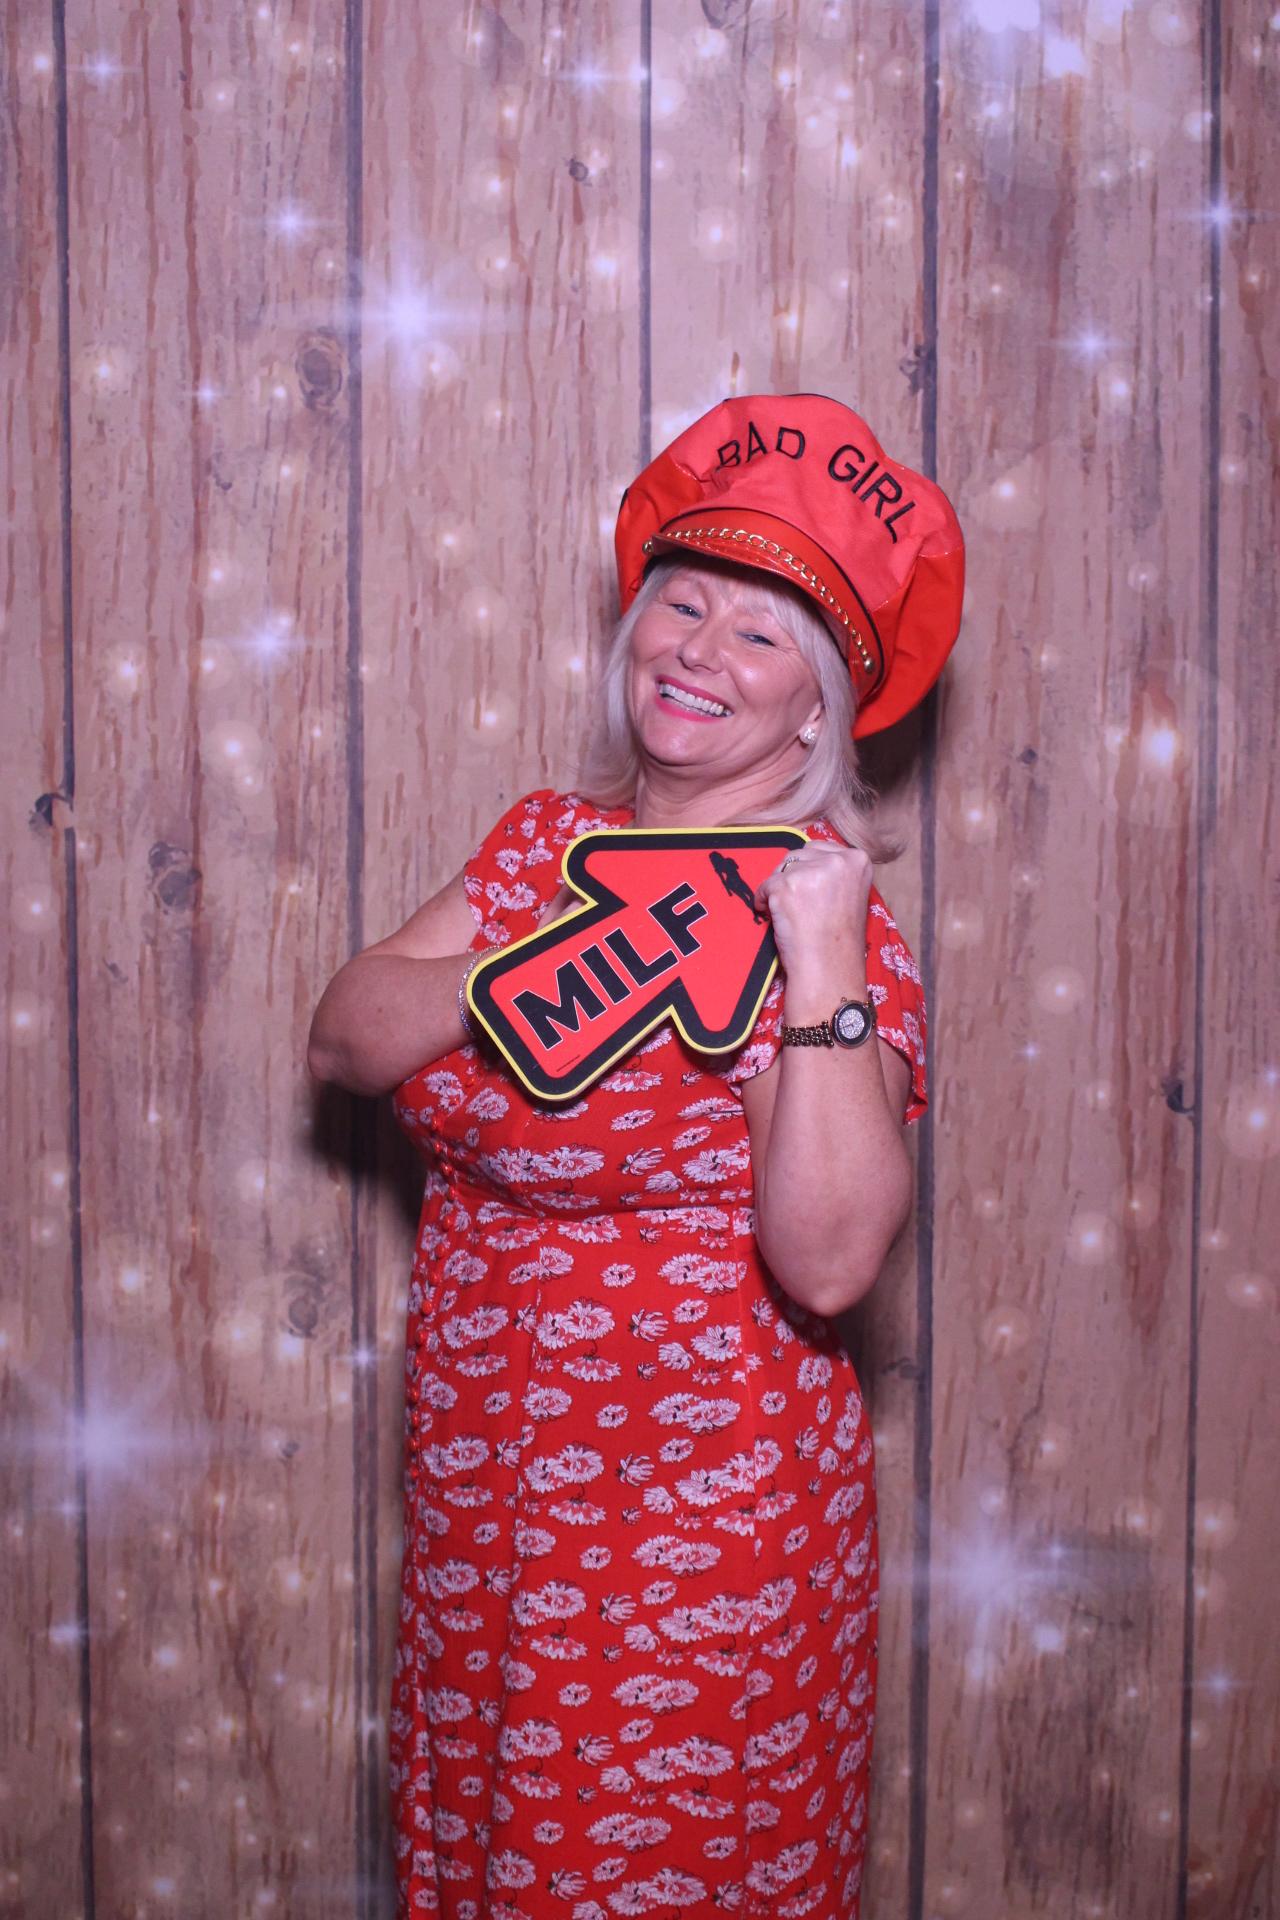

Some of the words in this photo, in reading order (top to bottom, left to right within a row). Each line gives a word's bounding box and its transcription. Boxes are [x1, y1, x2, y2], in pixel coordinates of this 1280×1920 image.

[716, 421, 806, 468] BAD
[827, 444, 916, 544] GIRL
[511, 881, 709, 1050] MILF
